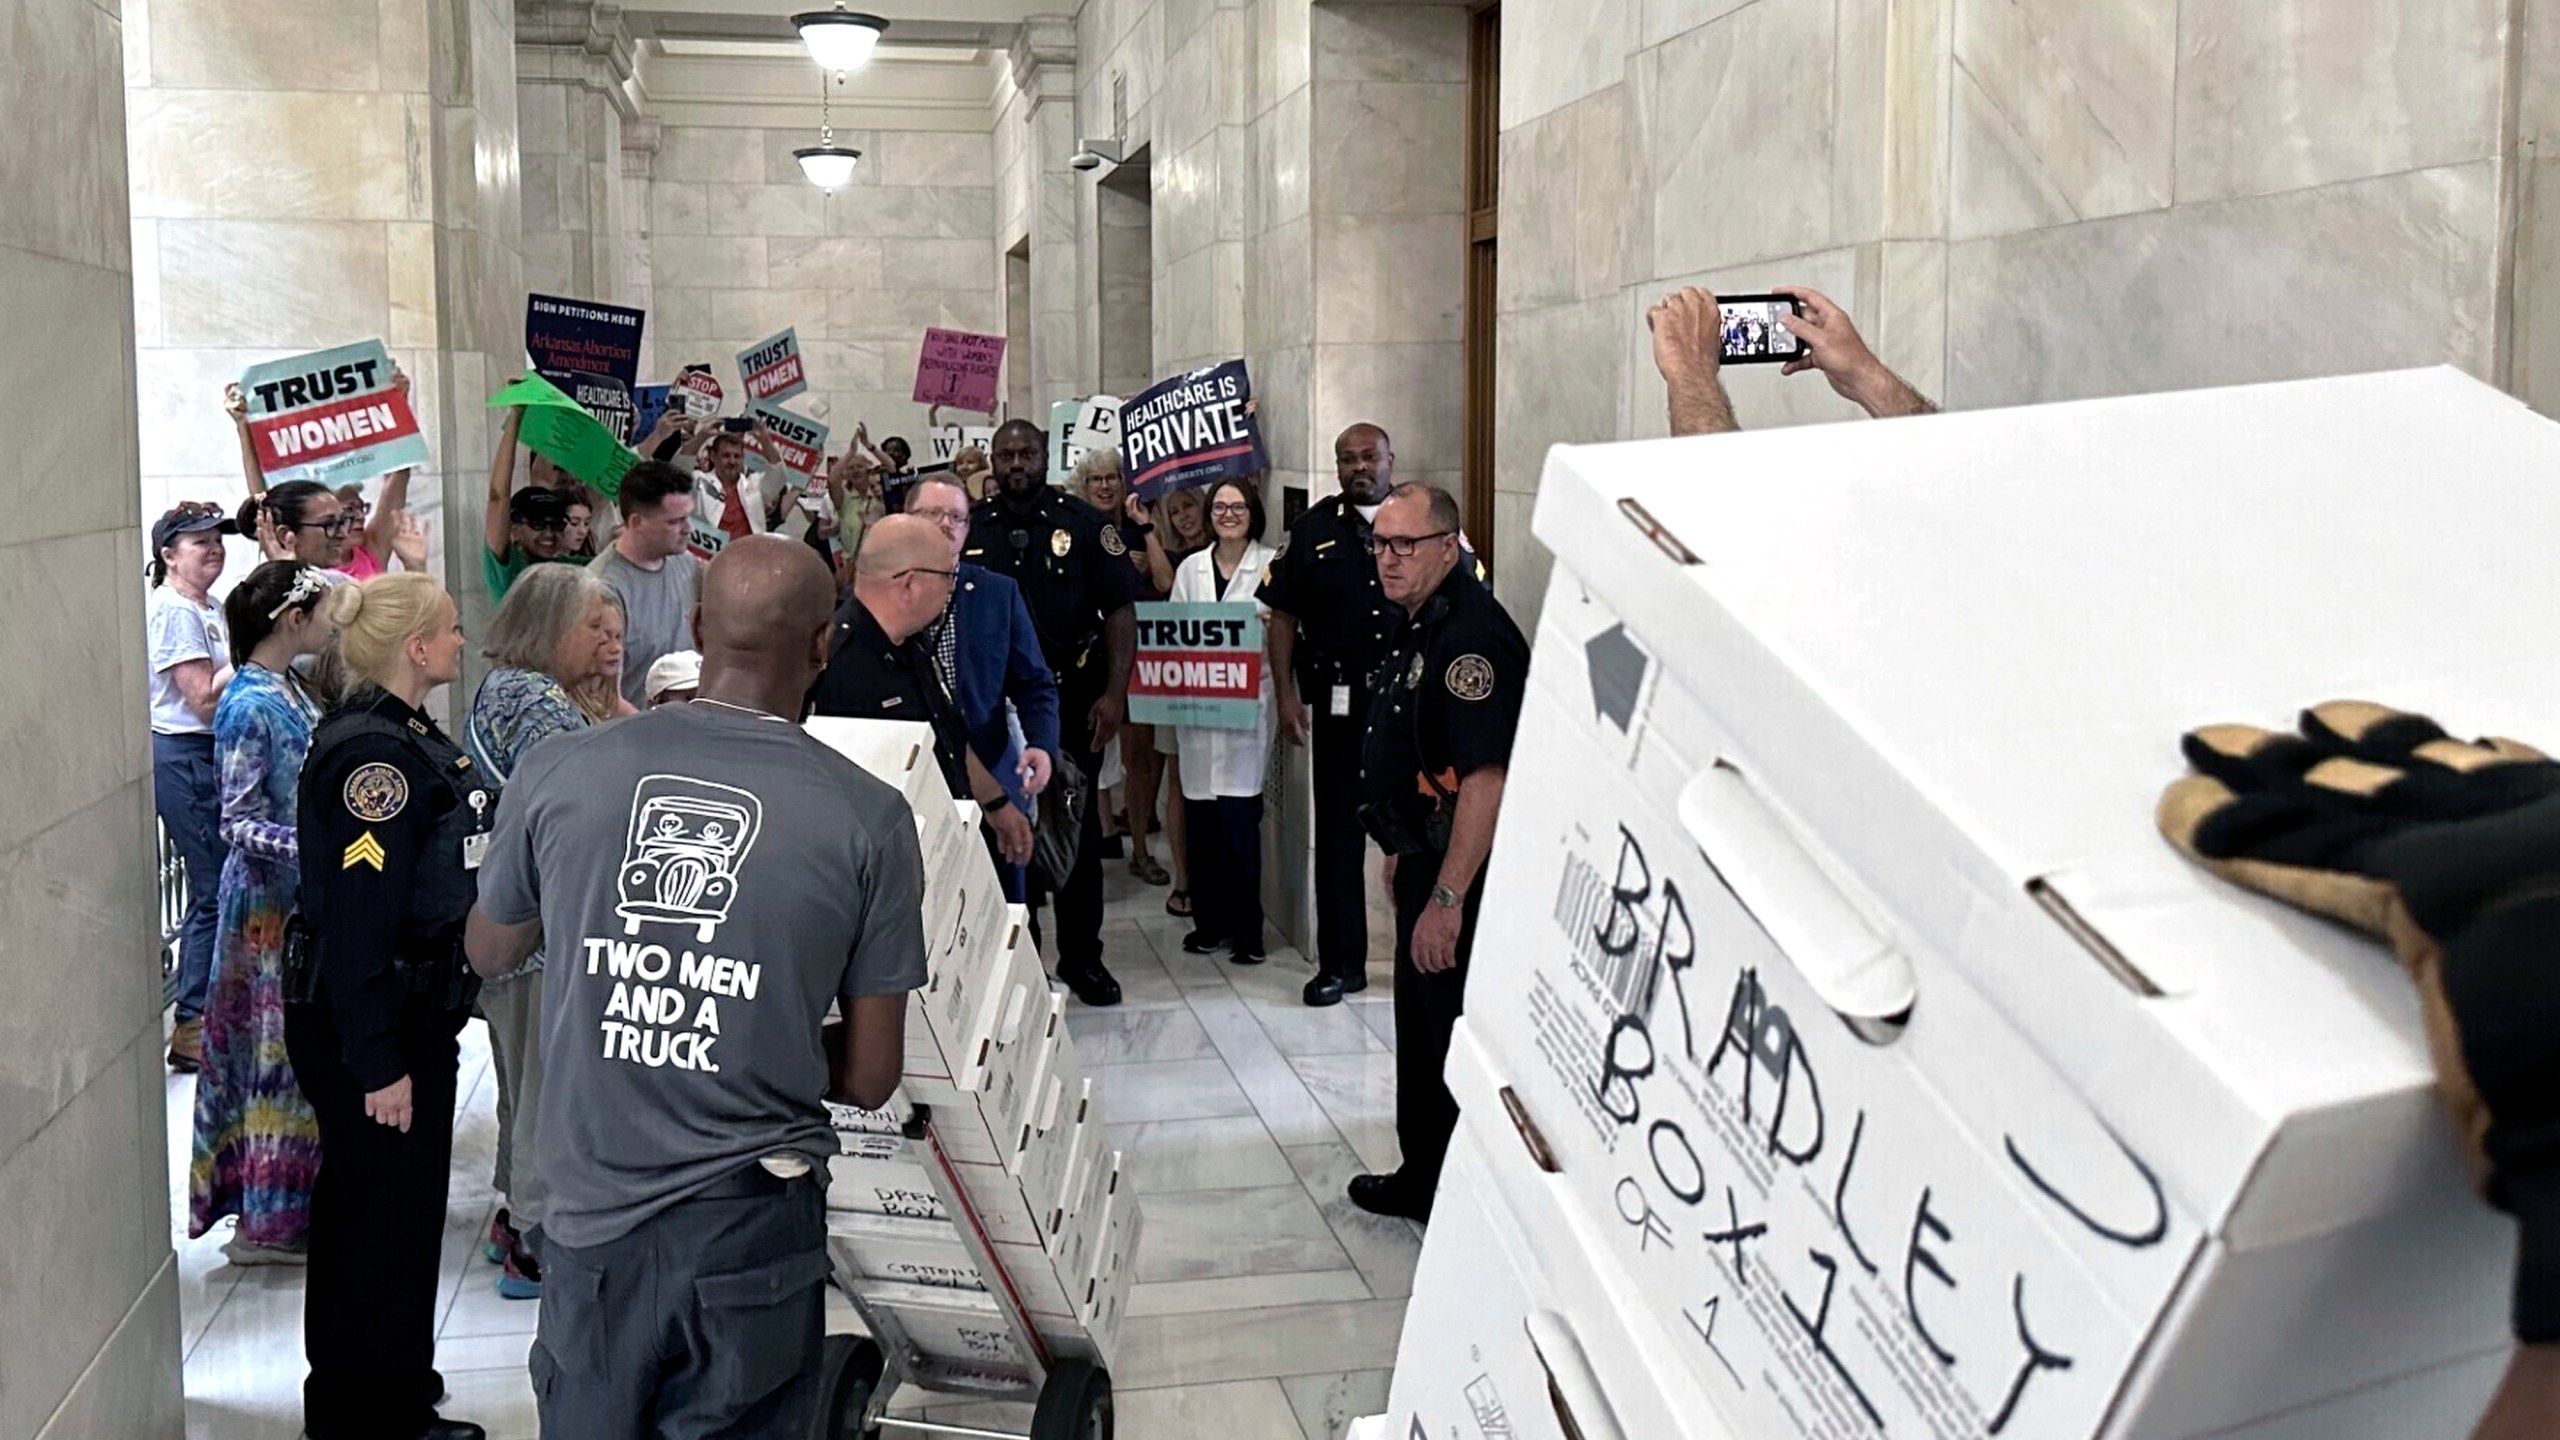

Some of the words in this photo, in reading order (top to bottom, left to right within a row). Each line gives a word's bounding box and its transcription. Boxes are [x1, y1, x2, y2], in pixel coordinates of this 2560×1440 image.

[533, 301, 556, 314] SIGN
[558, 304, 610, 323] PETITIONS
[611, 314, 637, 327] HERE
[531, 331, 582, 350] Arkansas
[584, 336, 631, 360] Abortion
[743, 337, 790, 375] TRUST
[961, 335, 979, 347] NOT
[547, 352, 610, 373] Amendment
[748, 359, 799, 397] WOMEN
[253, 359, 377, 413] TRUST
[577, 384, 621, 409] HEALTHCARE
[622, 391, 631, 409] IS
[688, 376, 718, 394] STOP
[1086, 406, 1116, 434] E
[1127, 381, 1214, 432] HEALTHCARE
[1218, 376, 1237, 398] IS
[268, 403, 397, 457] WOMEN
[755, 408, 817, 445] TRUST
[1127, 399, 1249, 471] PRIVATE
[933, 438, 955, 459] W
[691, 529, 722, 552] UST
[1137, 620, 1246, 647] TRUST
[1137, 661, 1248, 689] WOMEN
[583, 938, 671, 981] TWO
[679, 950, 761, 1000] MEN
[604, 982, 686, 1025] AND
[693, 996, 720, 1035] A
[600, 1021, 720, 1073] TRUCK.
[1594, 820, 2072, 1435] BRADLEY
[1587, 1014, 1768, 1285] BOX
[1781, 1248, 1885, 1429] 1
[1615, 1176, 1674, 1251] OF
